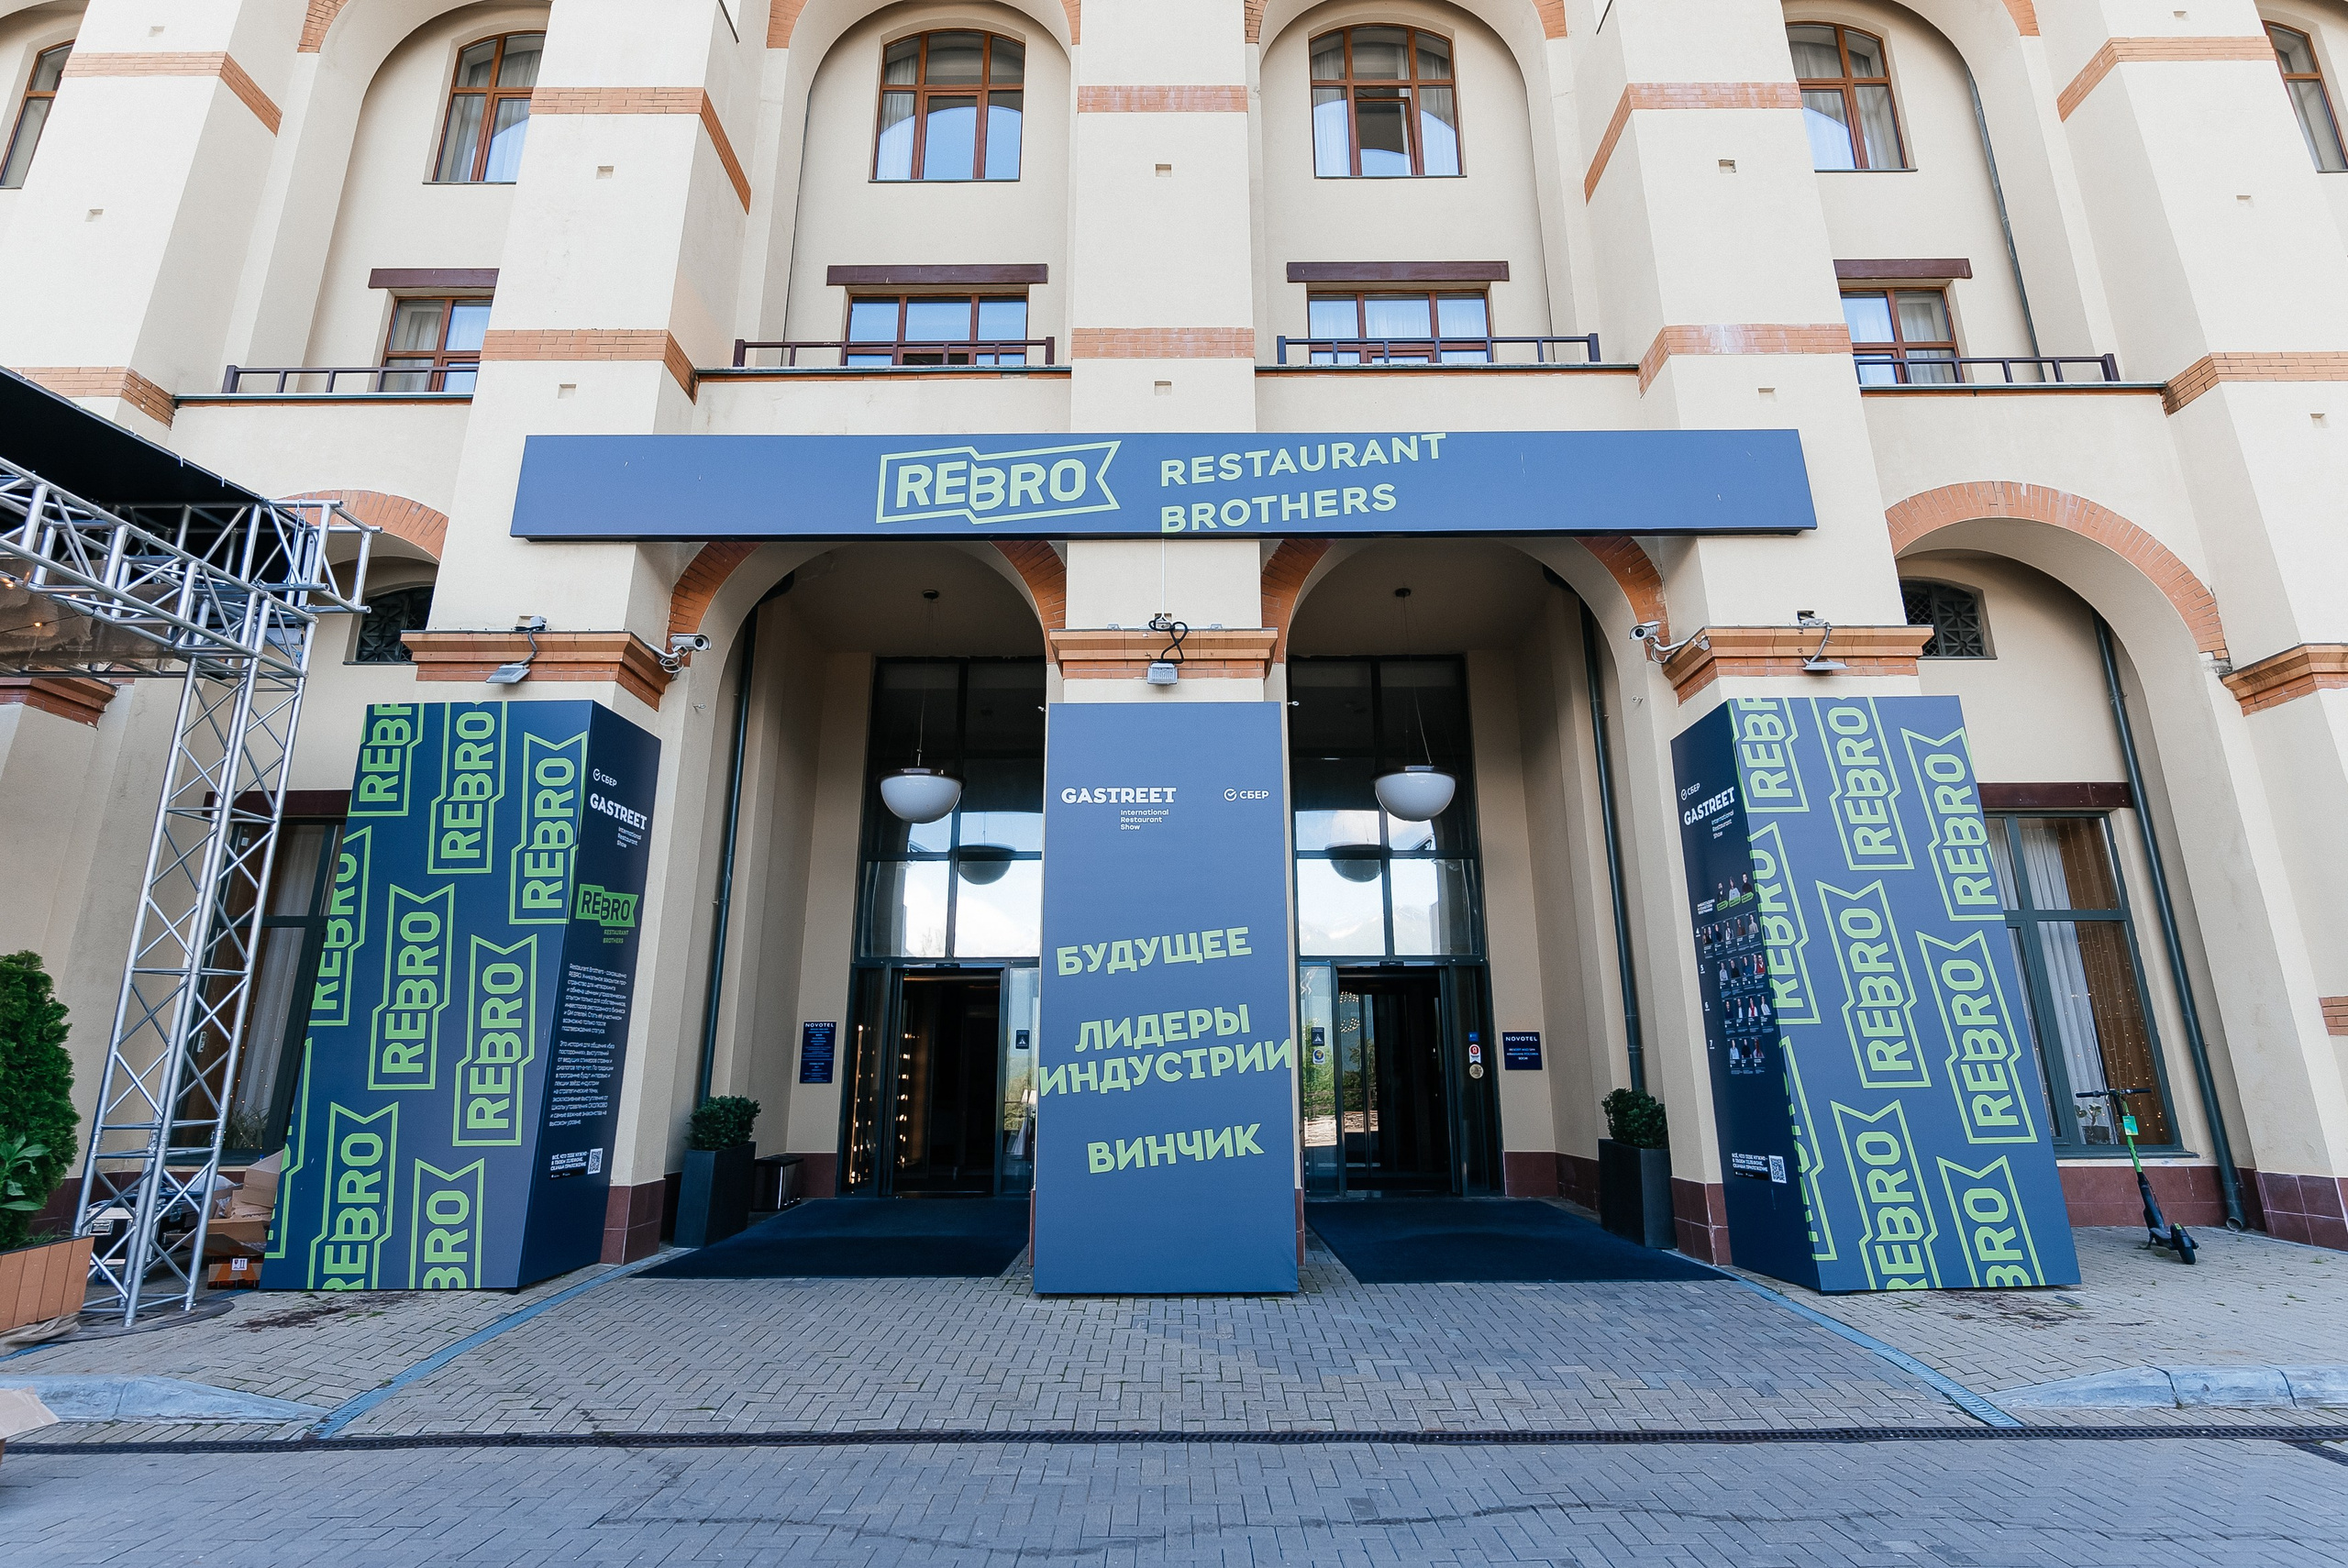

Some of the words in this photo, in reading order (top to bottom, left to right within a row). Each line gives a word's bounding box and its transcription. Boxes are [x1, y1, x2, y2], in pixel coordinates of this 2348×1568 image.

[895, 458, 1088, 513] REBRO
[1160, 432, 1447, 488] RESTAURANT
[1160, 482, 1398, 534] BROTHERS
[440, 711, 494, 860] REBRO
[601, 773, 617, 787] СБЕР
[1060, 787, 1177, 804] GASTREET
[1239, 790, 1269, 800] СБЕР
[1684, 786, 1735, 825] GASTREET
[1827, 707, 1898, 855] REBRO
[522, 756, 575, 910] REBRO
[590, 793, 648, 830] GASTREET
[1923, 754, 1999, 906] REBRO
[581, 889, 631, 922] REBRO
[1057, 926, 1252, 977] БУДУЩЕЕ
[381, 911, 441, 1074] REBRO
[1840, 909, 1913, 1071] REBRO
[466, 963, 524, 1130] REBRO
[1074, 1004, 1251, 1053] ЛИДЕРЫ
[1940, 960, 2019, 1126] REBRO
[1039, 1038, 1292, 1097] ИНДУСТРИИ
[1087, 1123, 1266, 1174] ВИНЧИК
